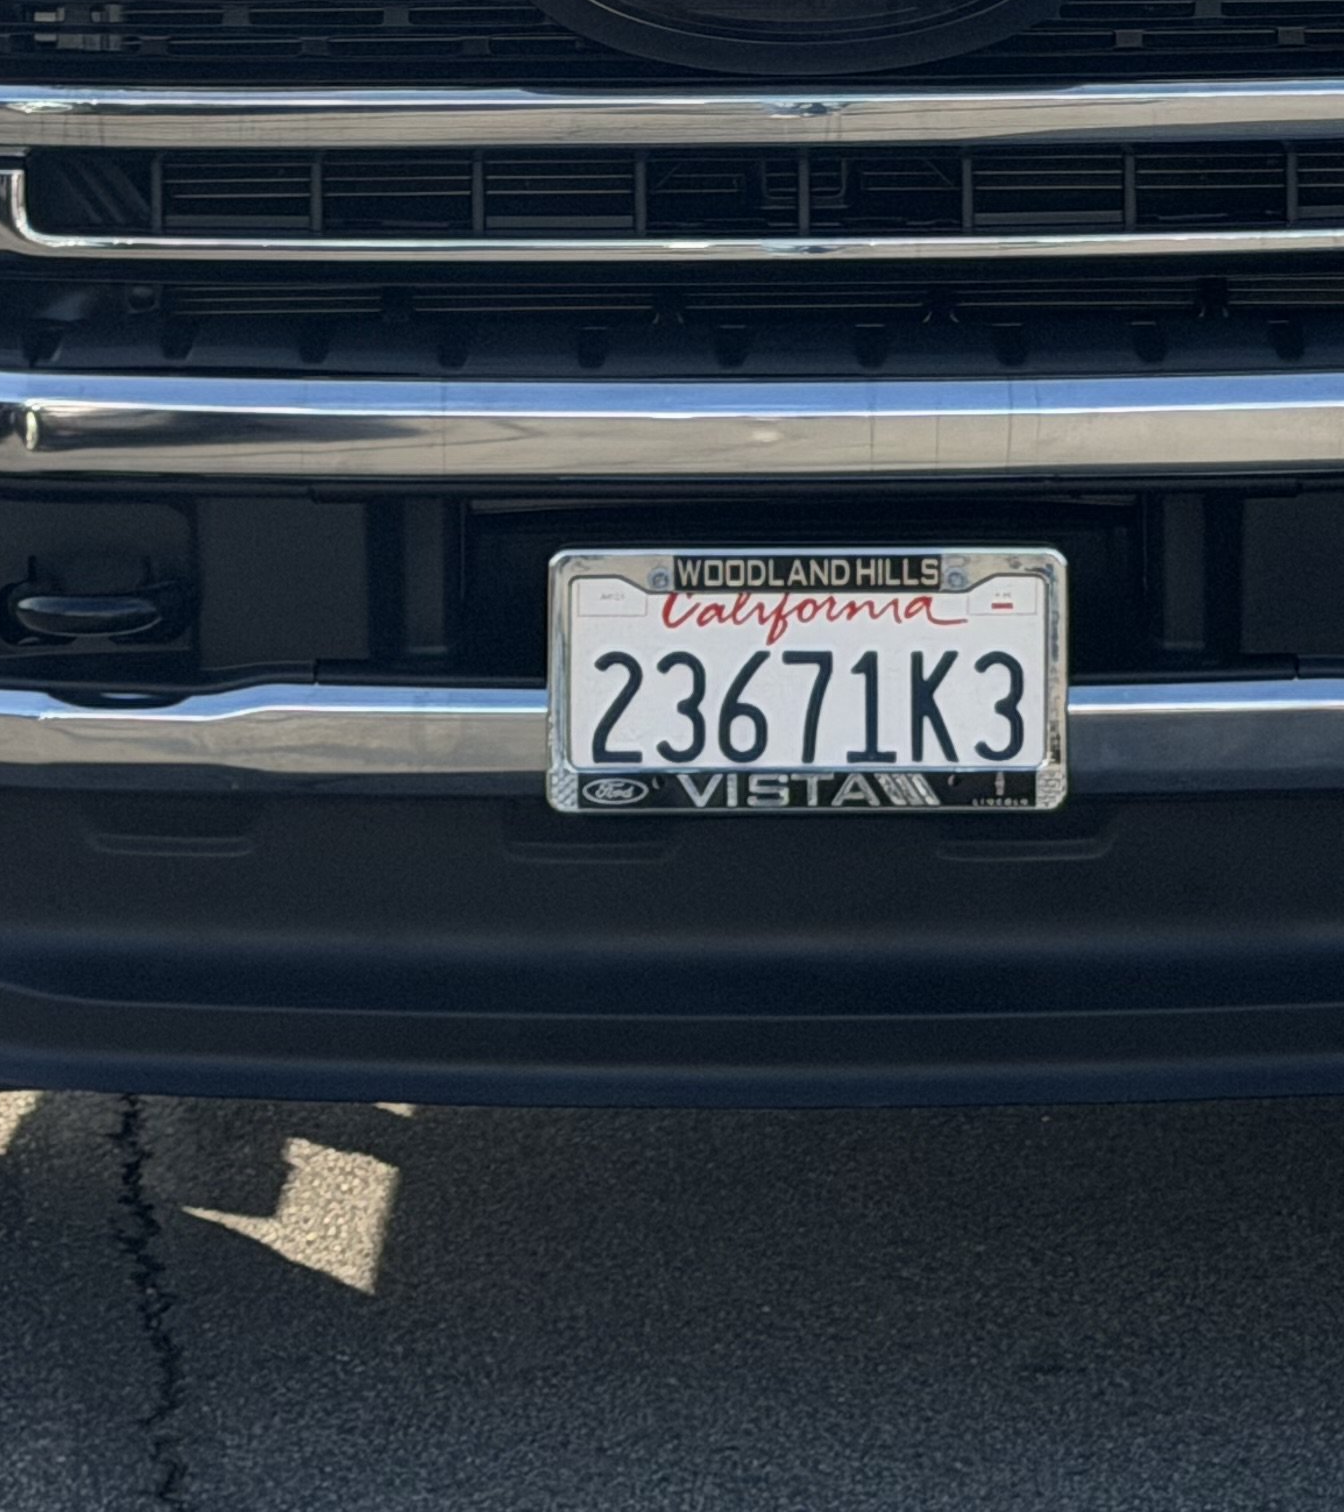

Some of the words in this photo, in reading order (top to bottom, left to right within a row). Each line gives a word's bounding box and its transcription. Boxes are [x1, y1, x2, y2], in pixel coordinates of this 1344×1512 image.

[676, 559, 850, 586] WOODLAND
[857, 560, 939, 586] HILLS
[661, 592, 968, 646] California
[592, 651, 1025, 763] 23671K3
[676, 774, 880, 807] VISTA
